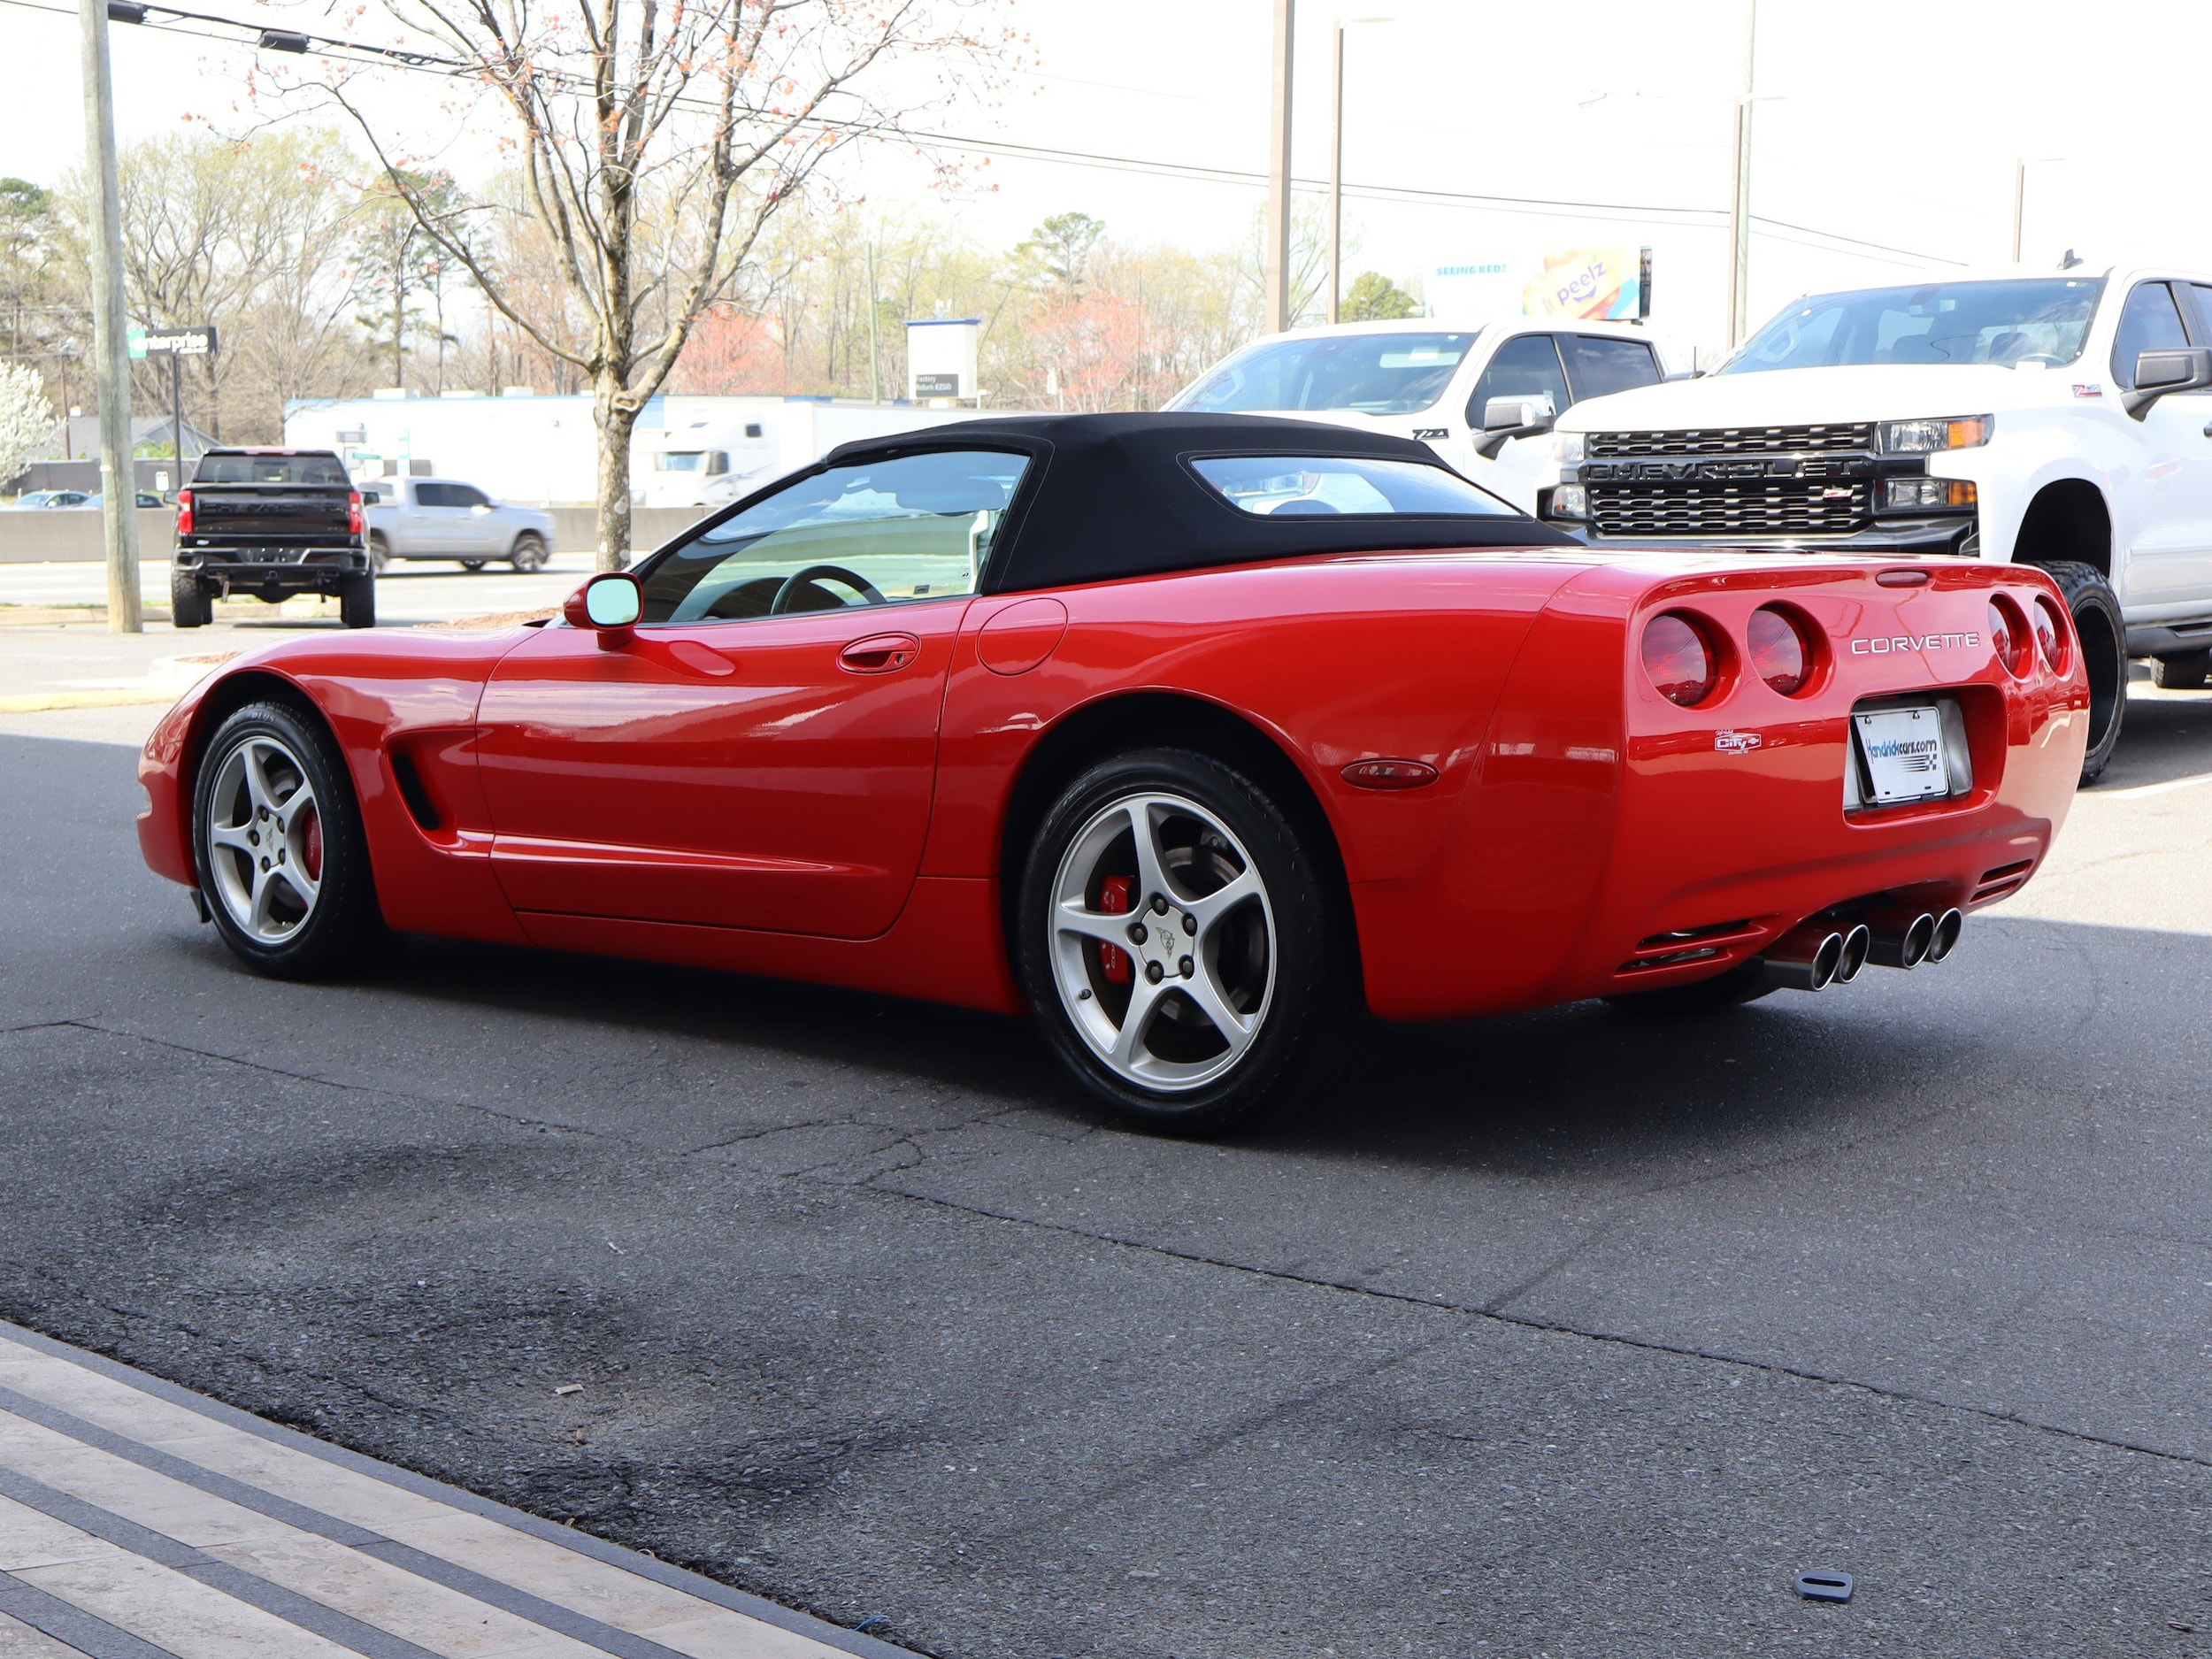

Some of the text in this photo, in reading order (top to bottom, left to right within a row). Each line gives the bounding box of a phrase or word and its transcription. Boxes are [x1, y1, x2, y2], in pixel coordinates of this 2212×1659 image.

[1436, 266, 1477, 276] SEEING
[1556, 261, 1607, 307] peelz
[1587, 460, 1863, 480] CHEVROLET
[1852, 633, 1980, 655] CORVETTE
